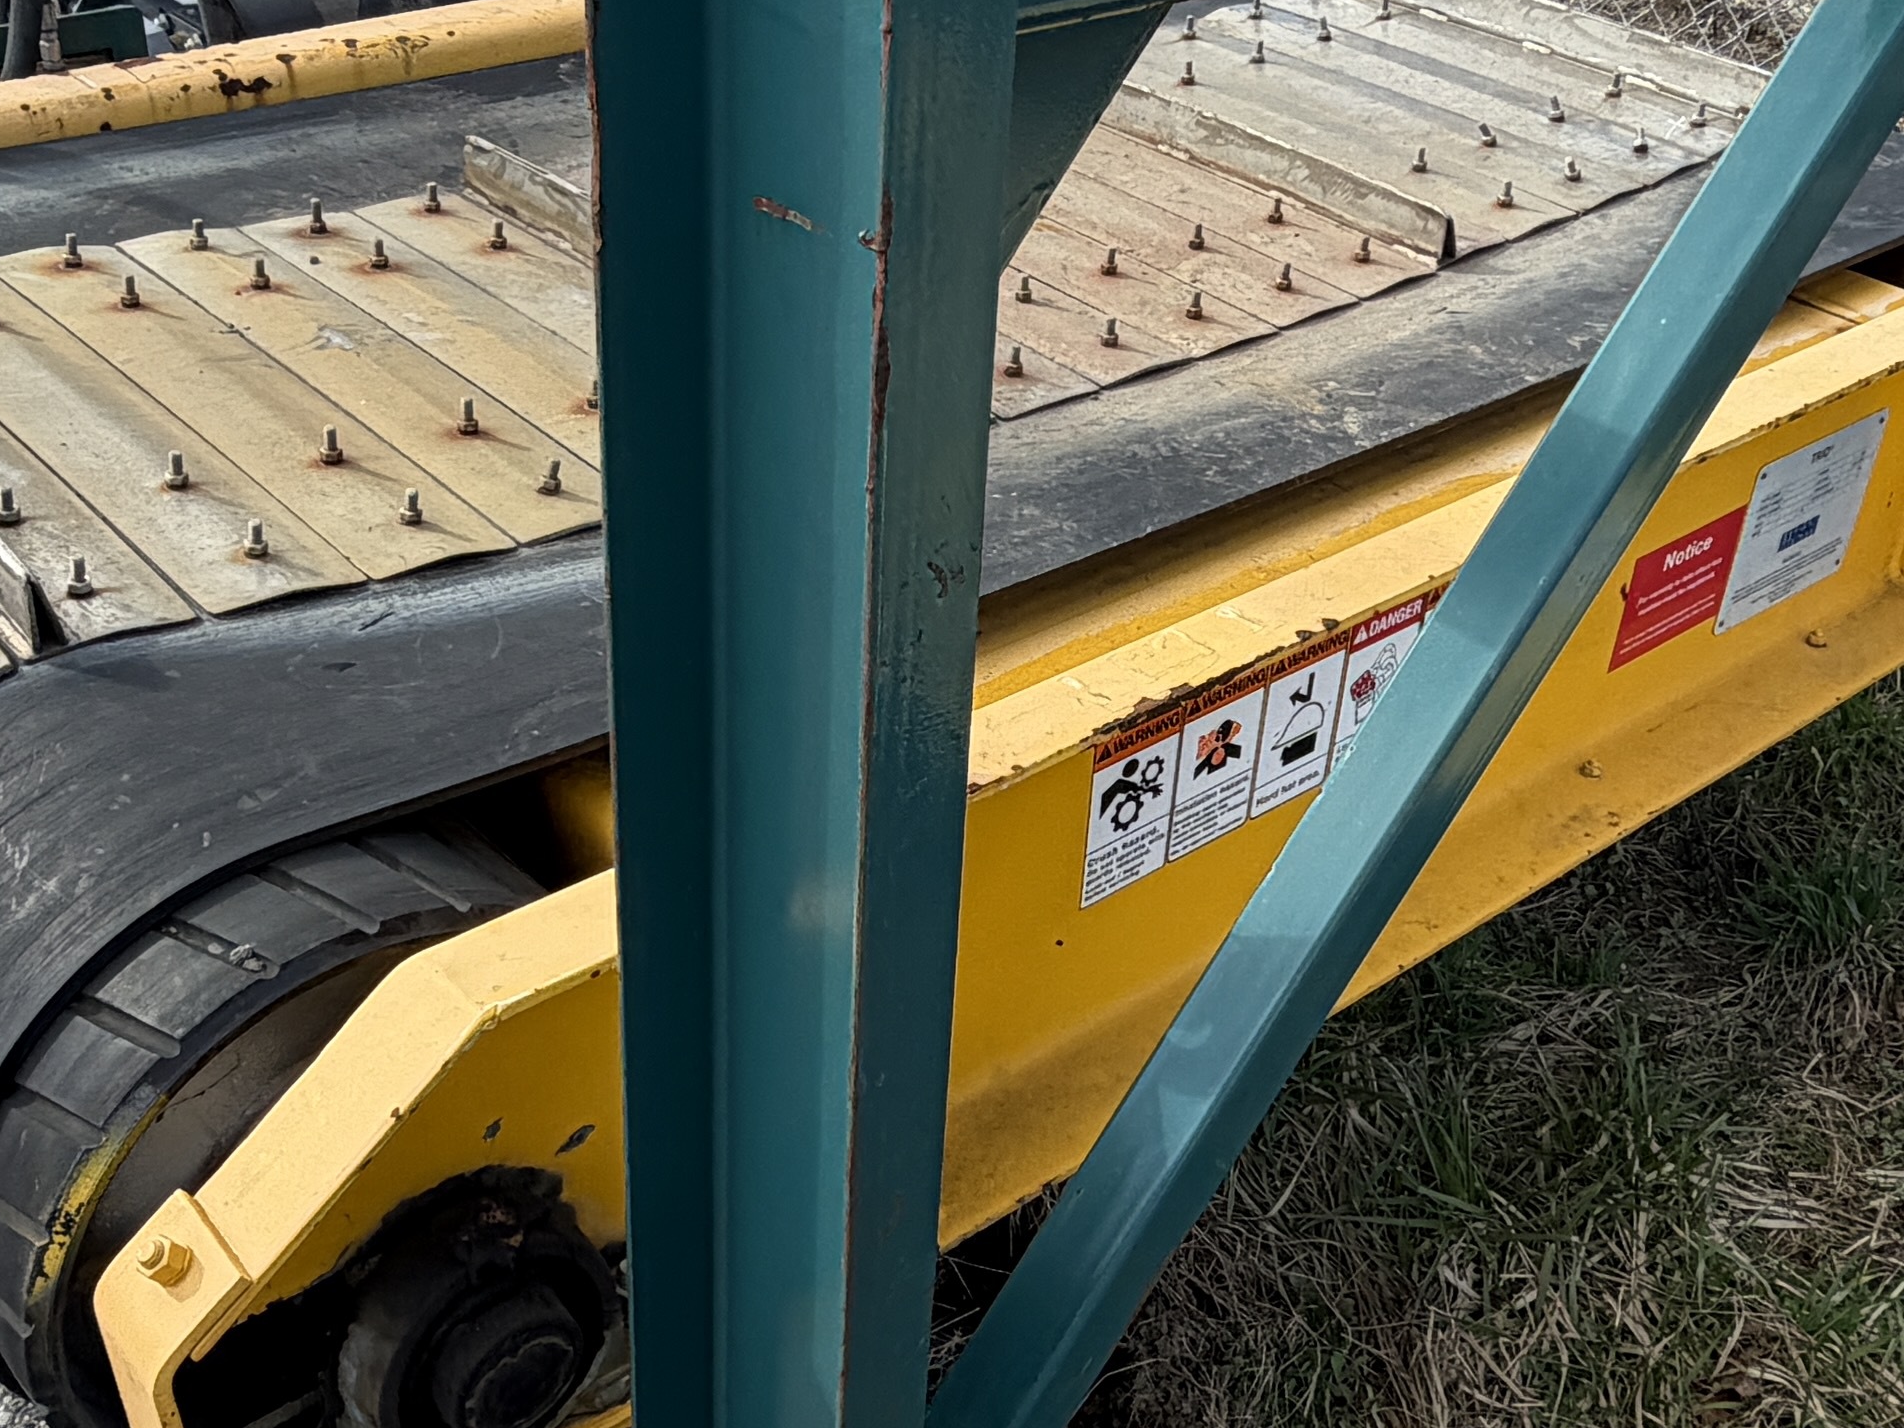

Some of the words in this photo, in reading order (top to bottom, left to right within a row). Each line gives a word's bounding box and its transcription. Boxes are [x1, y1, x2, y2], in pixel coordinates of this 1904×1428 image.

[1663, 536, 1714, 572] Notice
[1369, 599, 1424, 636] DANGER
[1287, 630, 1348, 671] WARNING
[1202, 670, 1266, 706] WARNING
[1114, 712, 1180, 754] WARNING
